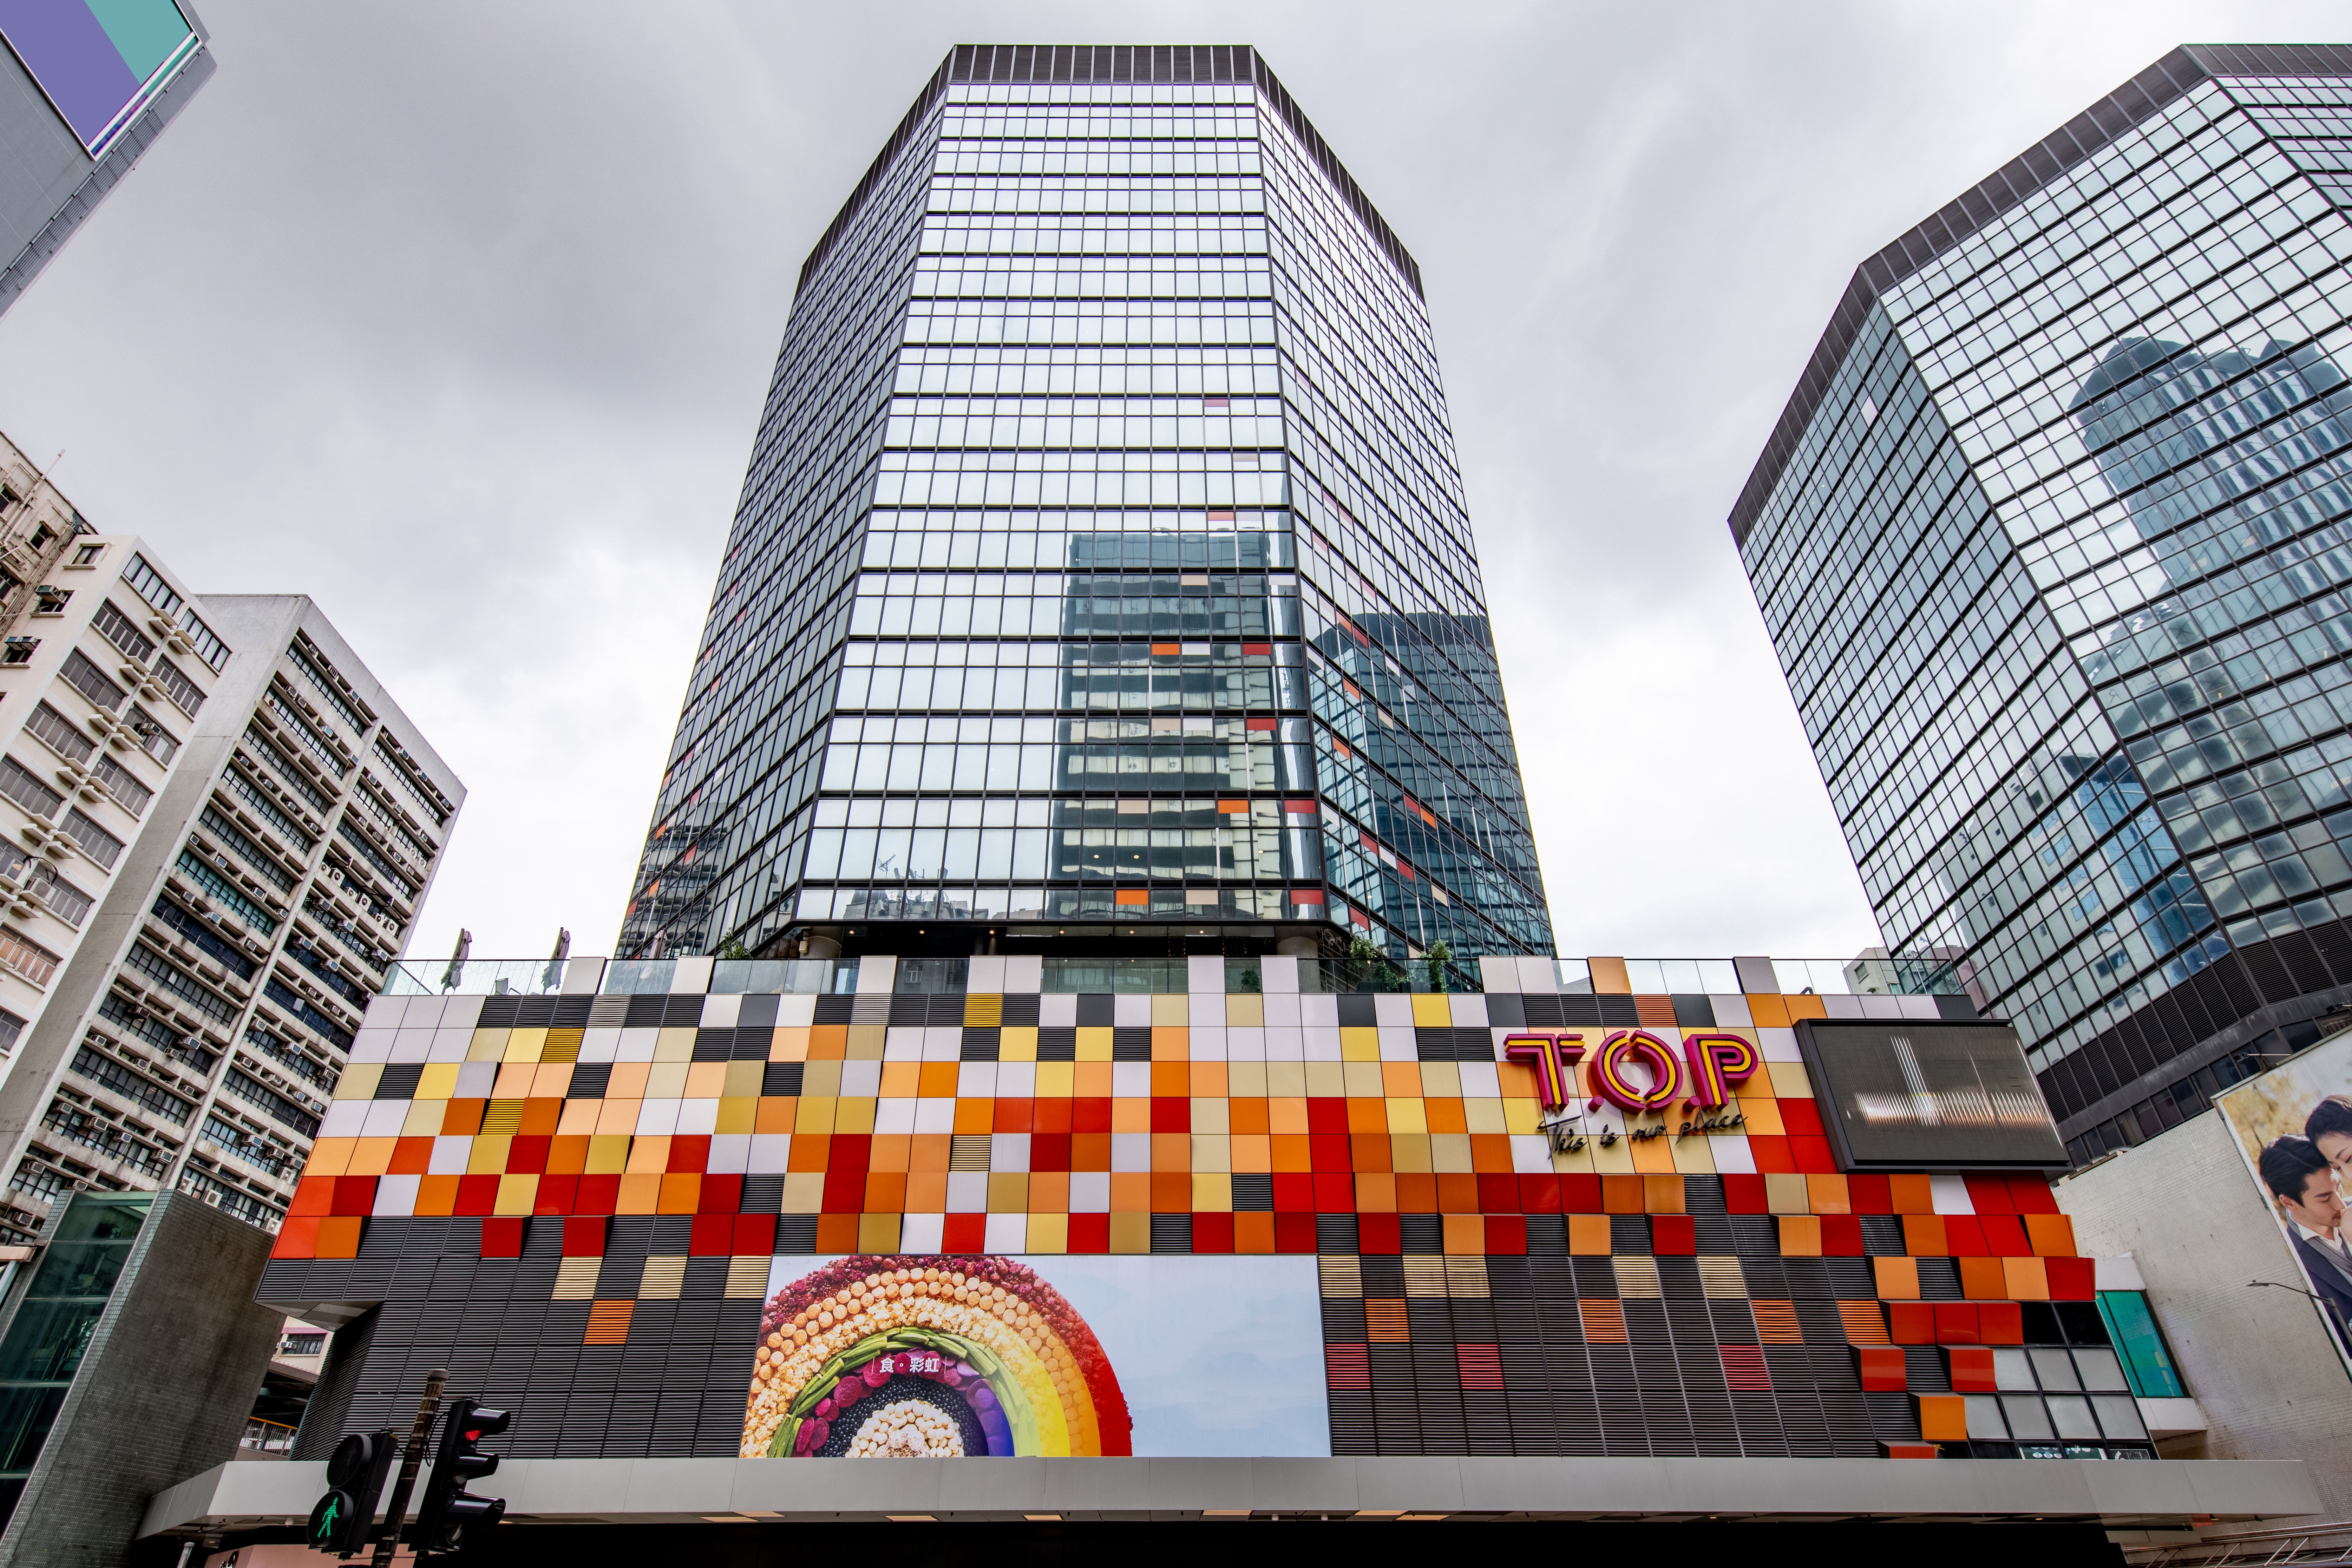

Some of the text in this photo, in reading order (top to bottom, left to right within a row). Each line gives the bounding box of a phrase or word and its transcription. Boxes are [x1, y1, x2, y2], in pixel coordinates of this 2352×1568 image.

[1537, 1110, 1748, 1160] This is our place
